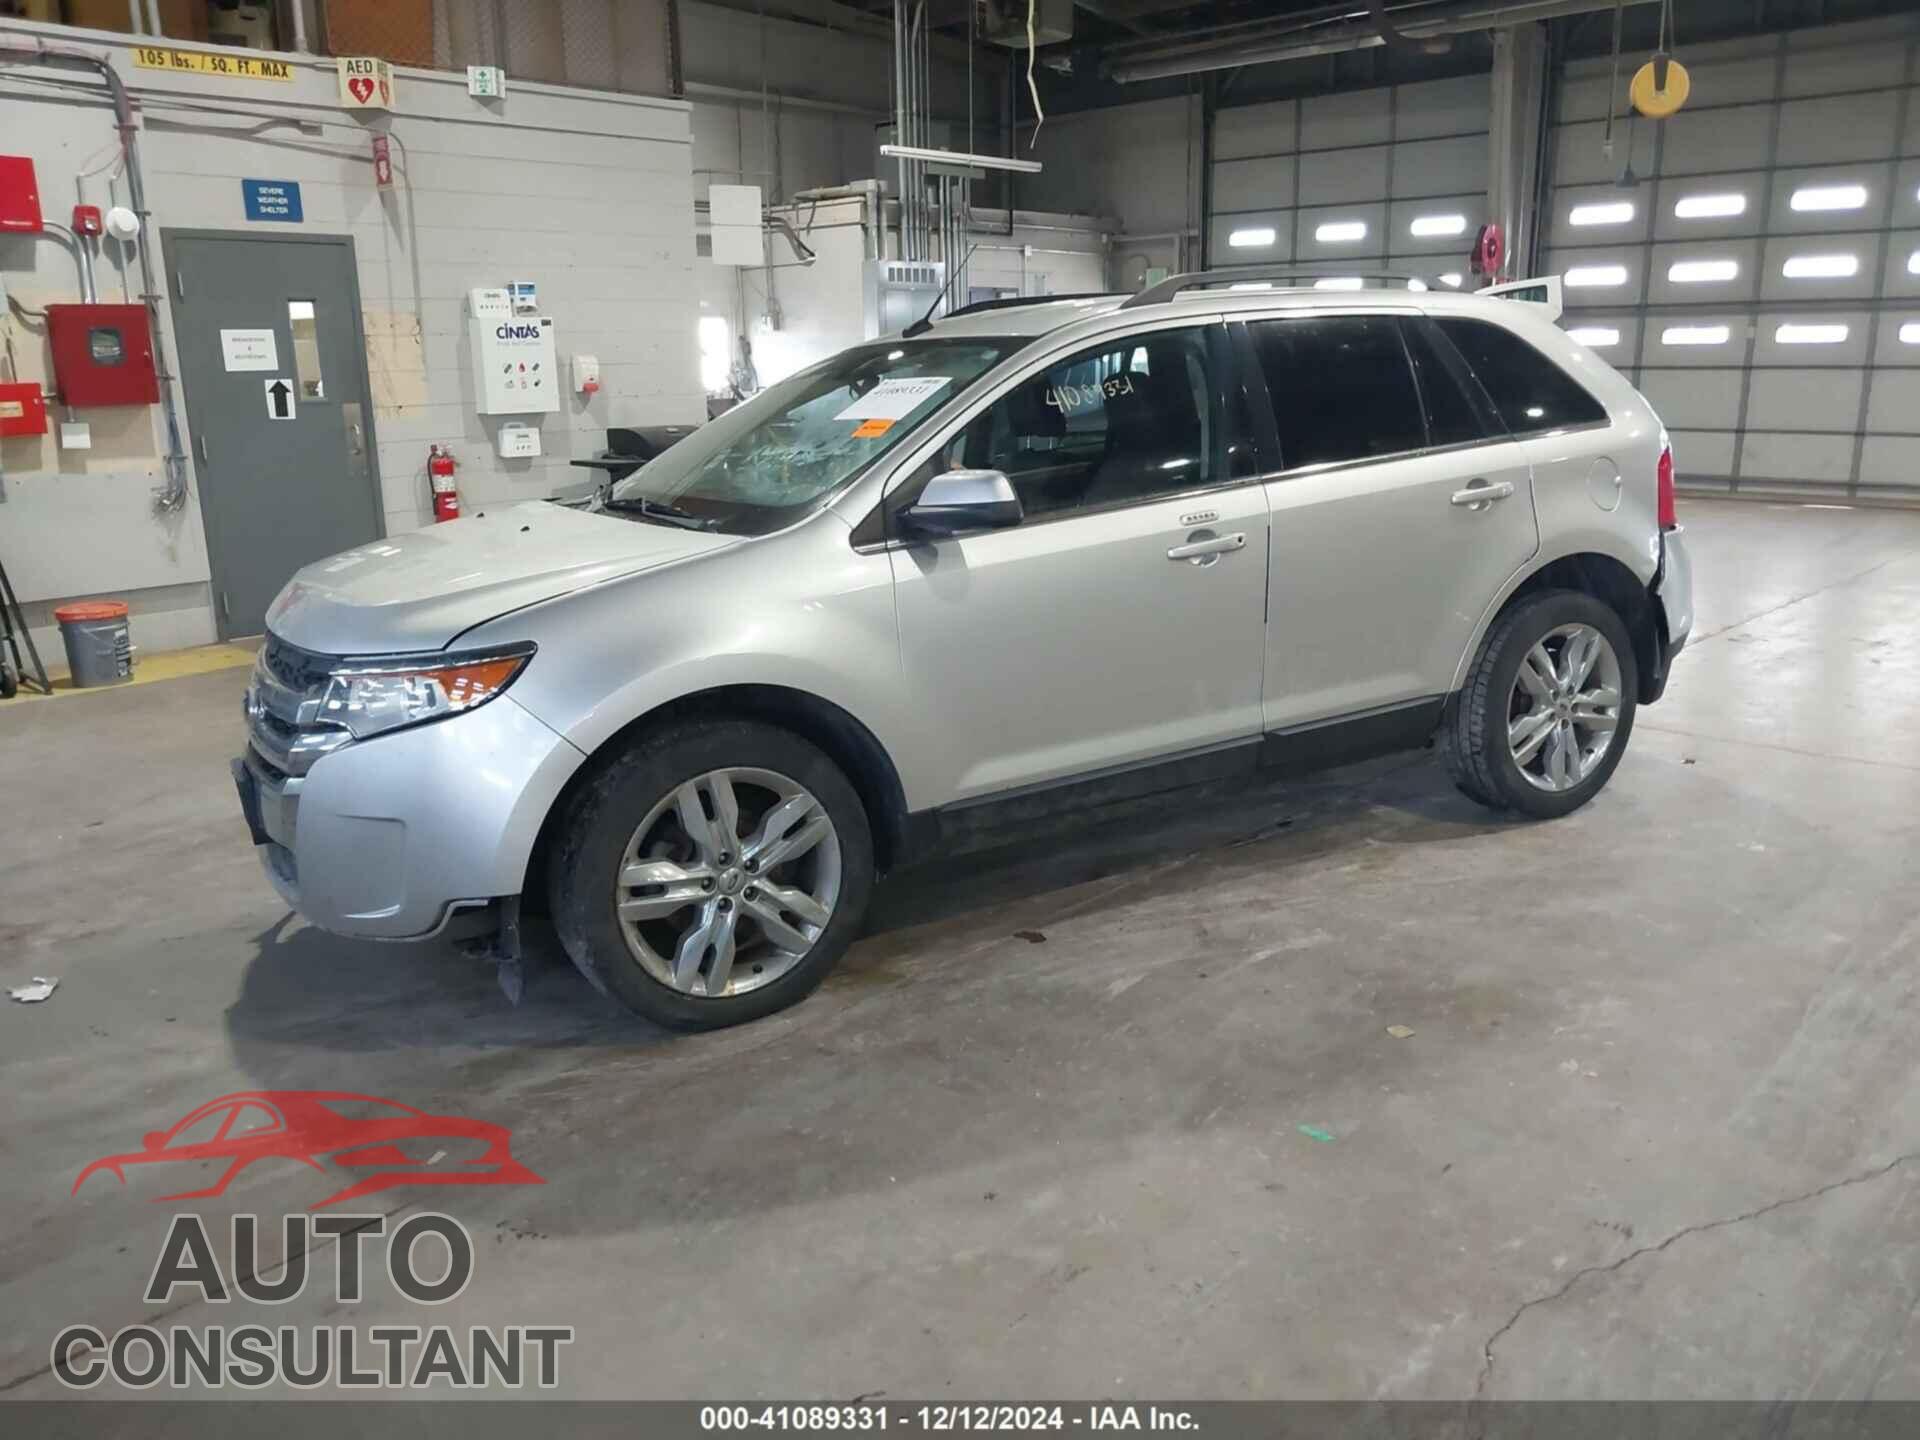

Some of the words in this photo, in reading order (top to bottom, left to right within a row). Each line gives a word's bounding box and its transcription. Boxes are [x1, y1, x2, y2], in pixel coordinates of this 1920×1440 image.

[138, 49, 165, 65] 105
[170, 51, 196, 69] lbs.
[211, 57, 233, 73] SQ.
[238, 60, 256, 76] FT.
[261, 62, 289, 78] MAX
[346, 60, 373, 74] AED
[260, 206, 289, 214] SHELTER
